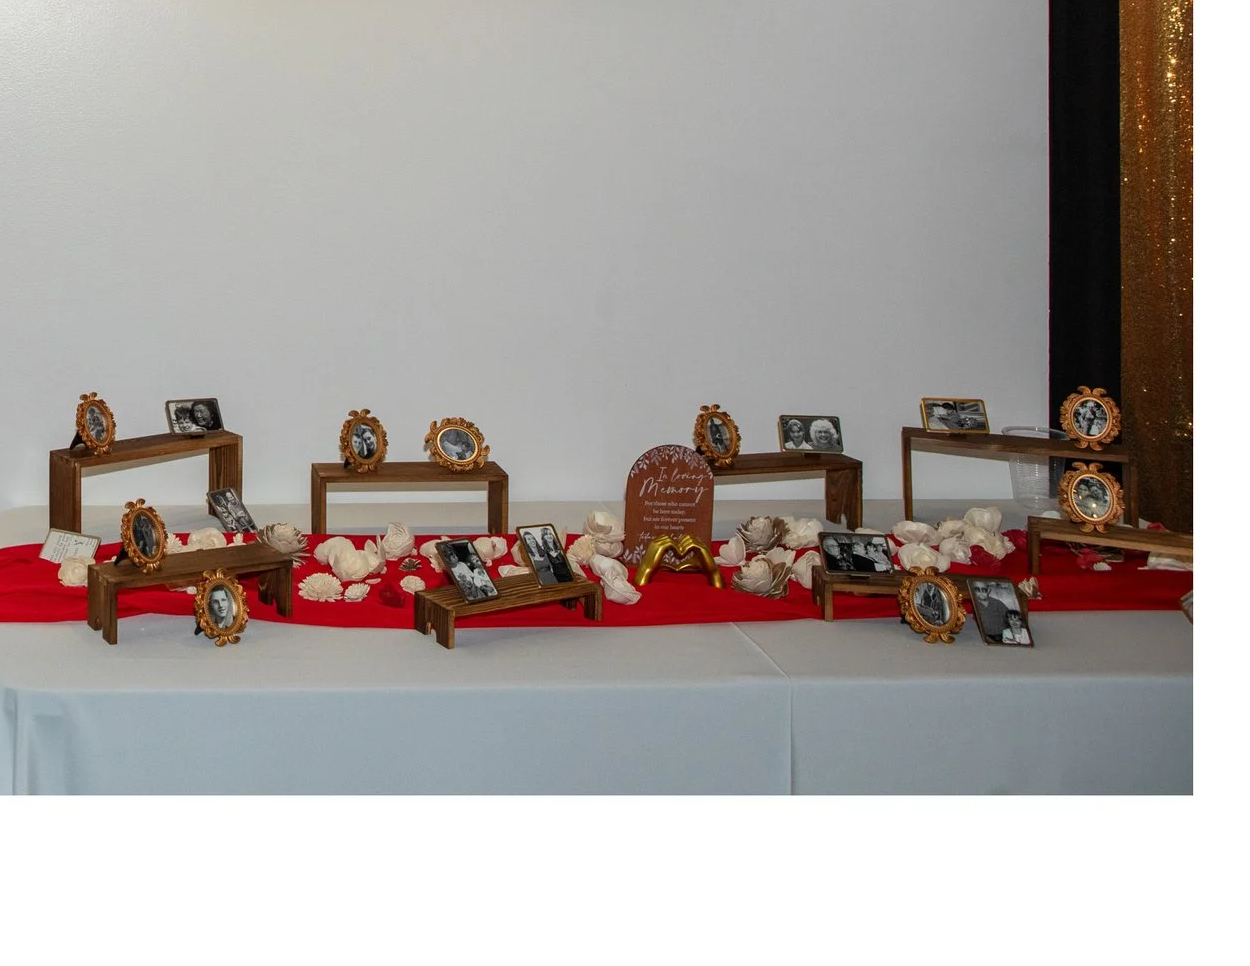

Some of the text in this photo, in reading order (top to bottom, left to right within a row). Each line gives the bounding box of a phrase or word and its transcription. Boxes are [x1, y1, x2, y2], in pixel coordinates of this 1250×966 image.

[657, 467, 708, 486] In loving
[639, 477, 708, 504] Memory
